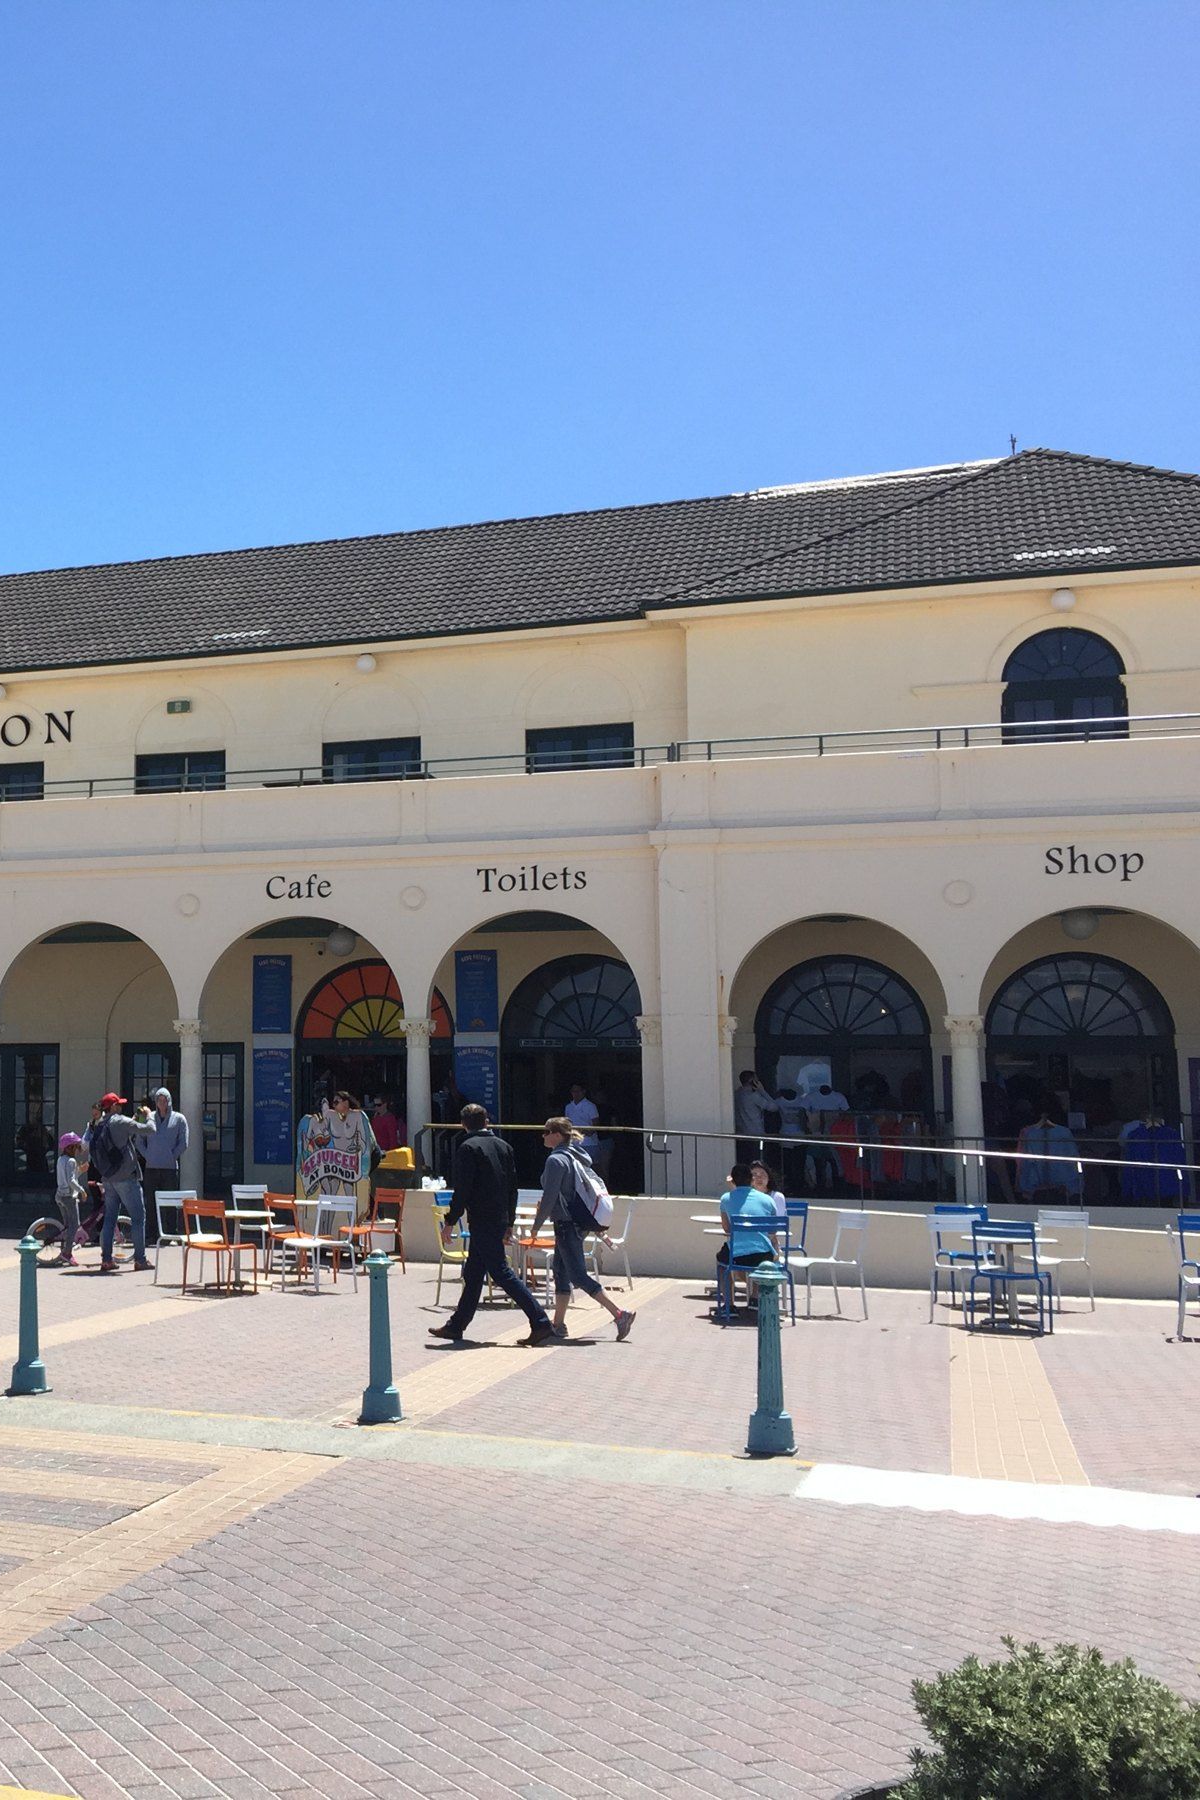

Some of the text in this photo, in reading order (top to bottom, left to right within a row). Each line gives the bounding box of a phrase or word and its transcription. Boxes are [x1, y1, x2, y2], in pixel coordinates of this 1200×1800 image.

[1045, 846, 1144, 882] Shop
[266, 874, 332, 899] Cafe
[477, 865, 586, 892] Toilets
[309, 1165, 354, 1184] AT BONDI
